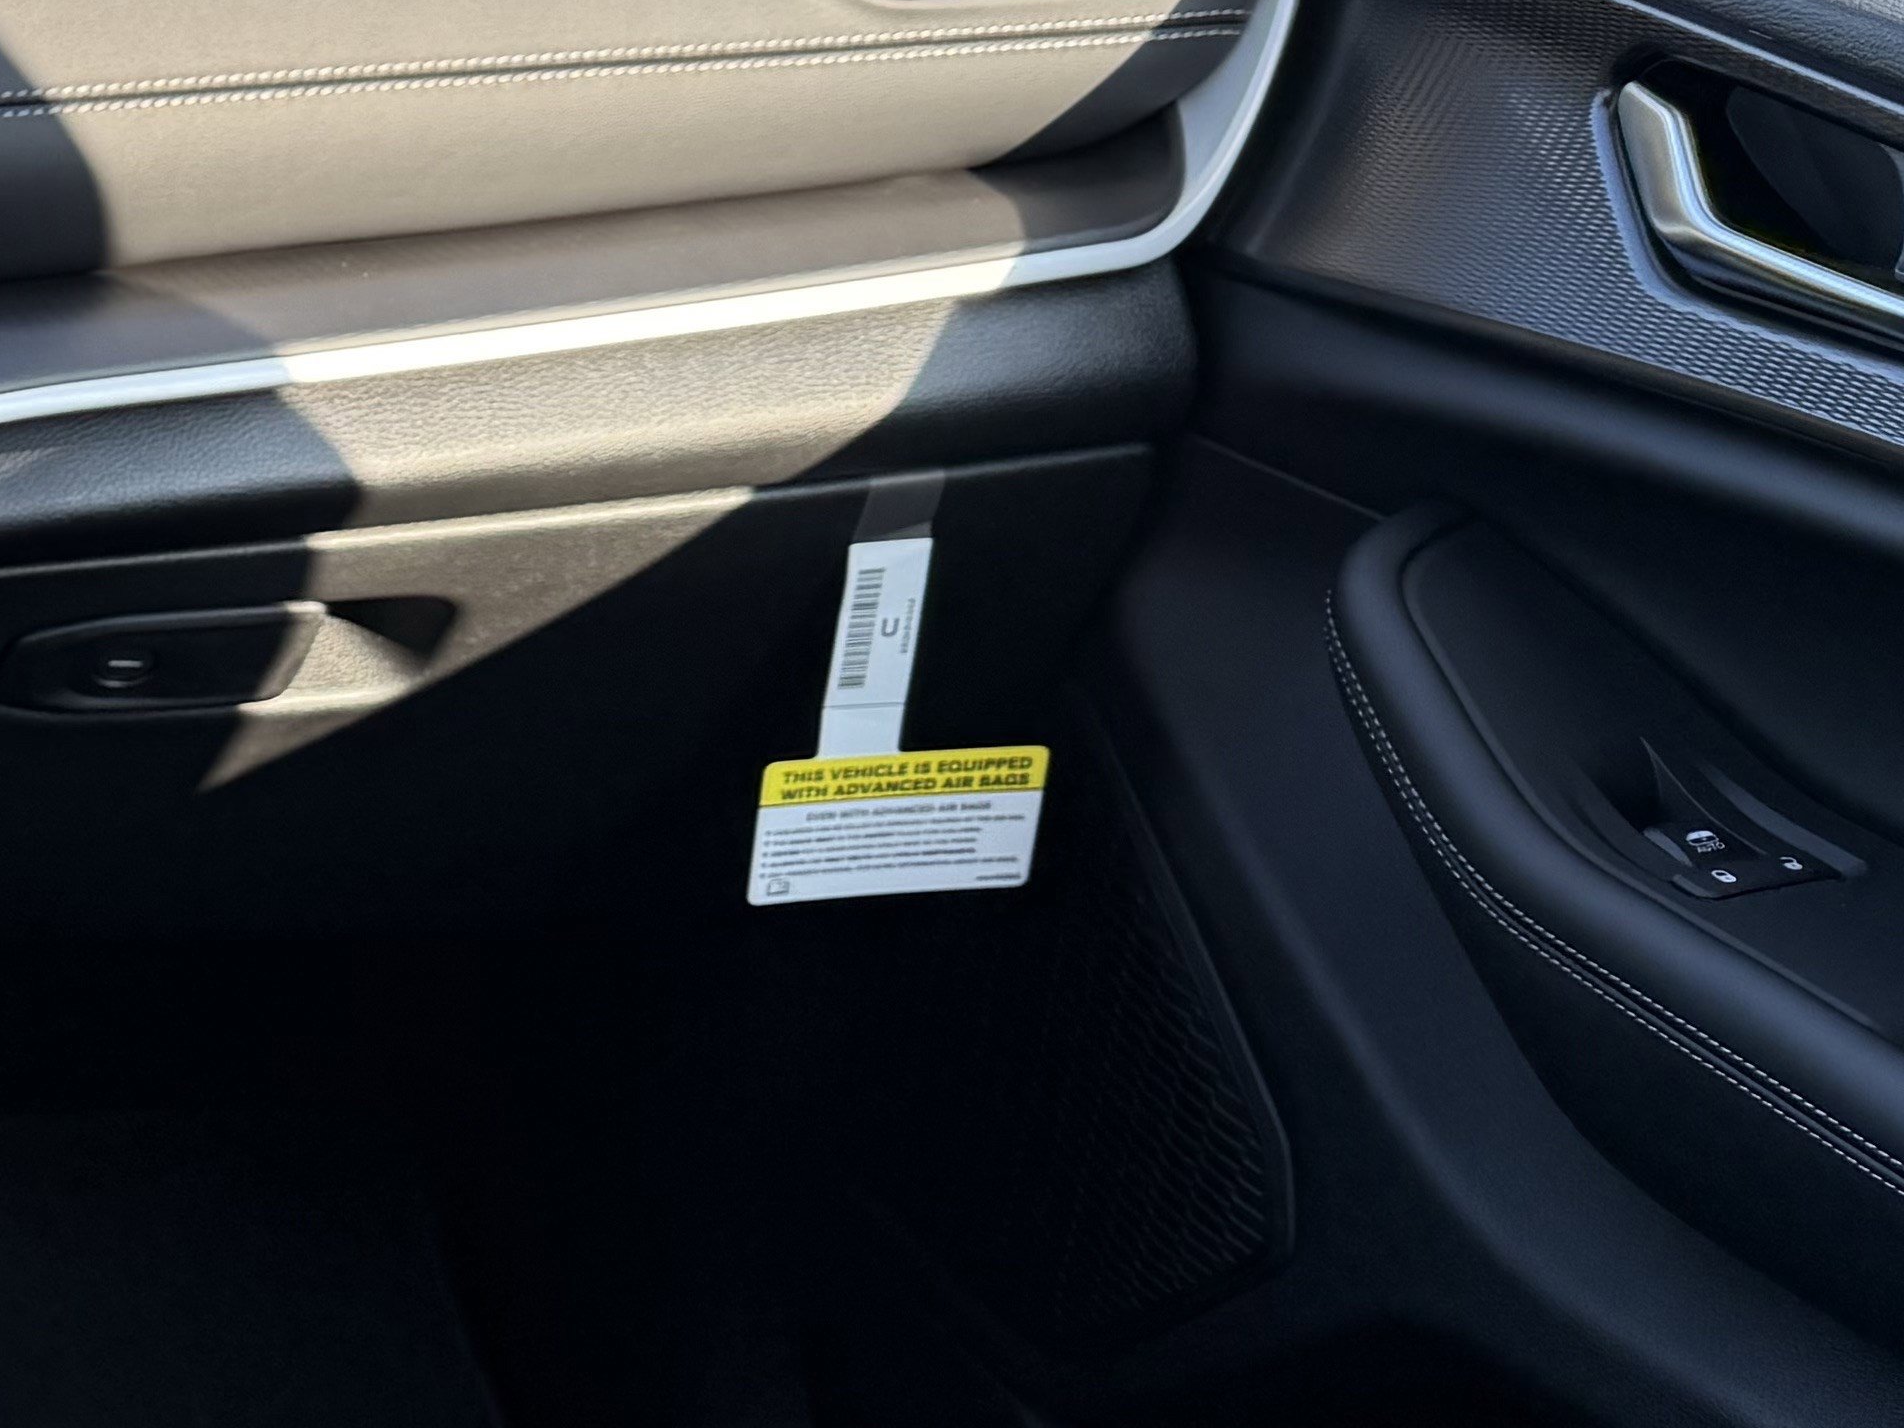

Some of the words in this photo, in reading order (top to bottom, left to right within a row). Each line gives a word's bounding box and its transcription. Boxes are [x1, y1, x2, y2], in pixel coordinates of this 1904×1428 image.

[783, 770, 825, 784] THIS
[830, 762, 911, 781] VEHICLE
[913, 761, 932, 774] IS
[938, 756, 1033, 773] EQUIPPED
[781, 786, 829, 800] WITH
[834, 778, 937, 795] ADVANCED
[942, 775, 975, 789] AIR
[978, 773, 1030, 787] BAGS
